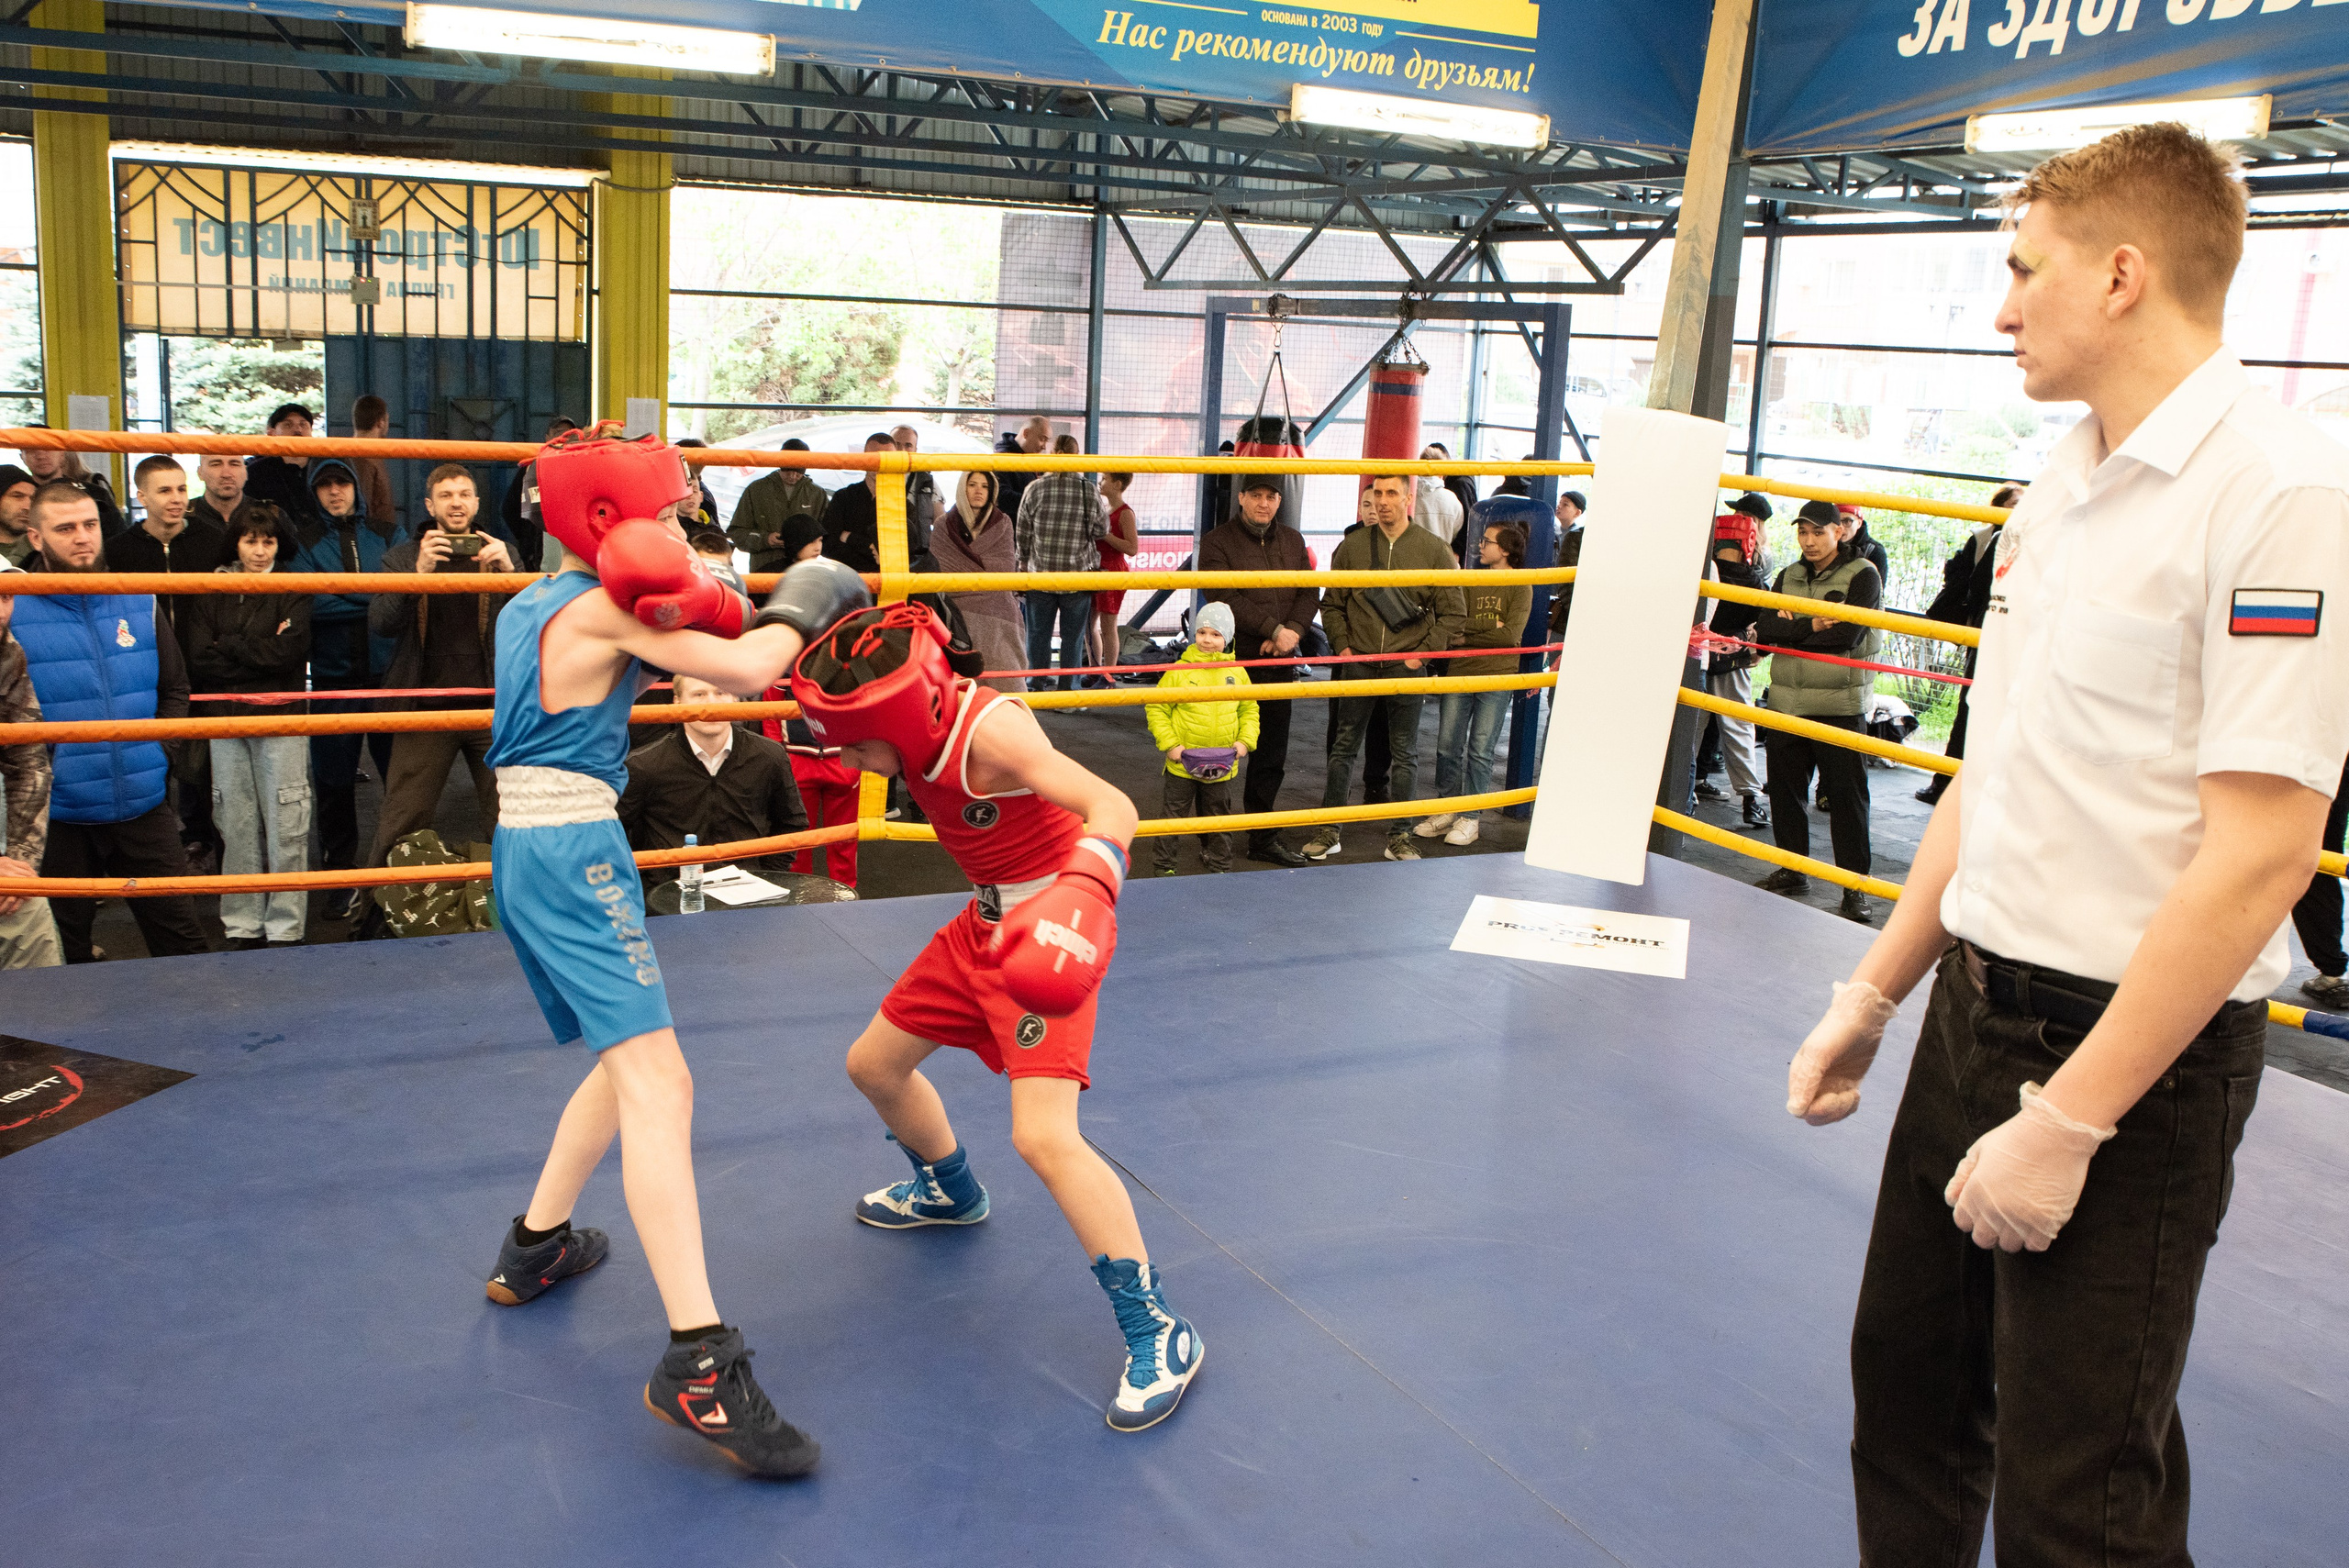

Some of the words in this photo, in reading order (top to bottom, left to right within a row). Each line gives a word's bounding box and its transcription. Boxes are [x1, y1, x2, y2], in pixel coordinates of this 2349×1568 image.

[1261, 9, 1308, 28] ОСНОВАНА
[1311, 16, 1319, 28] В
[1321, 14, 1358, 33] 2003
[1898, 0, 1969, 57] ЗА
[1097, 10, 1167, 50] Нас
[1170, 28, 1396, 78] рекомендуют
[1404, 48, 1536, 94] друзьям!
[0, 1075, 61, 1105] IGHT
